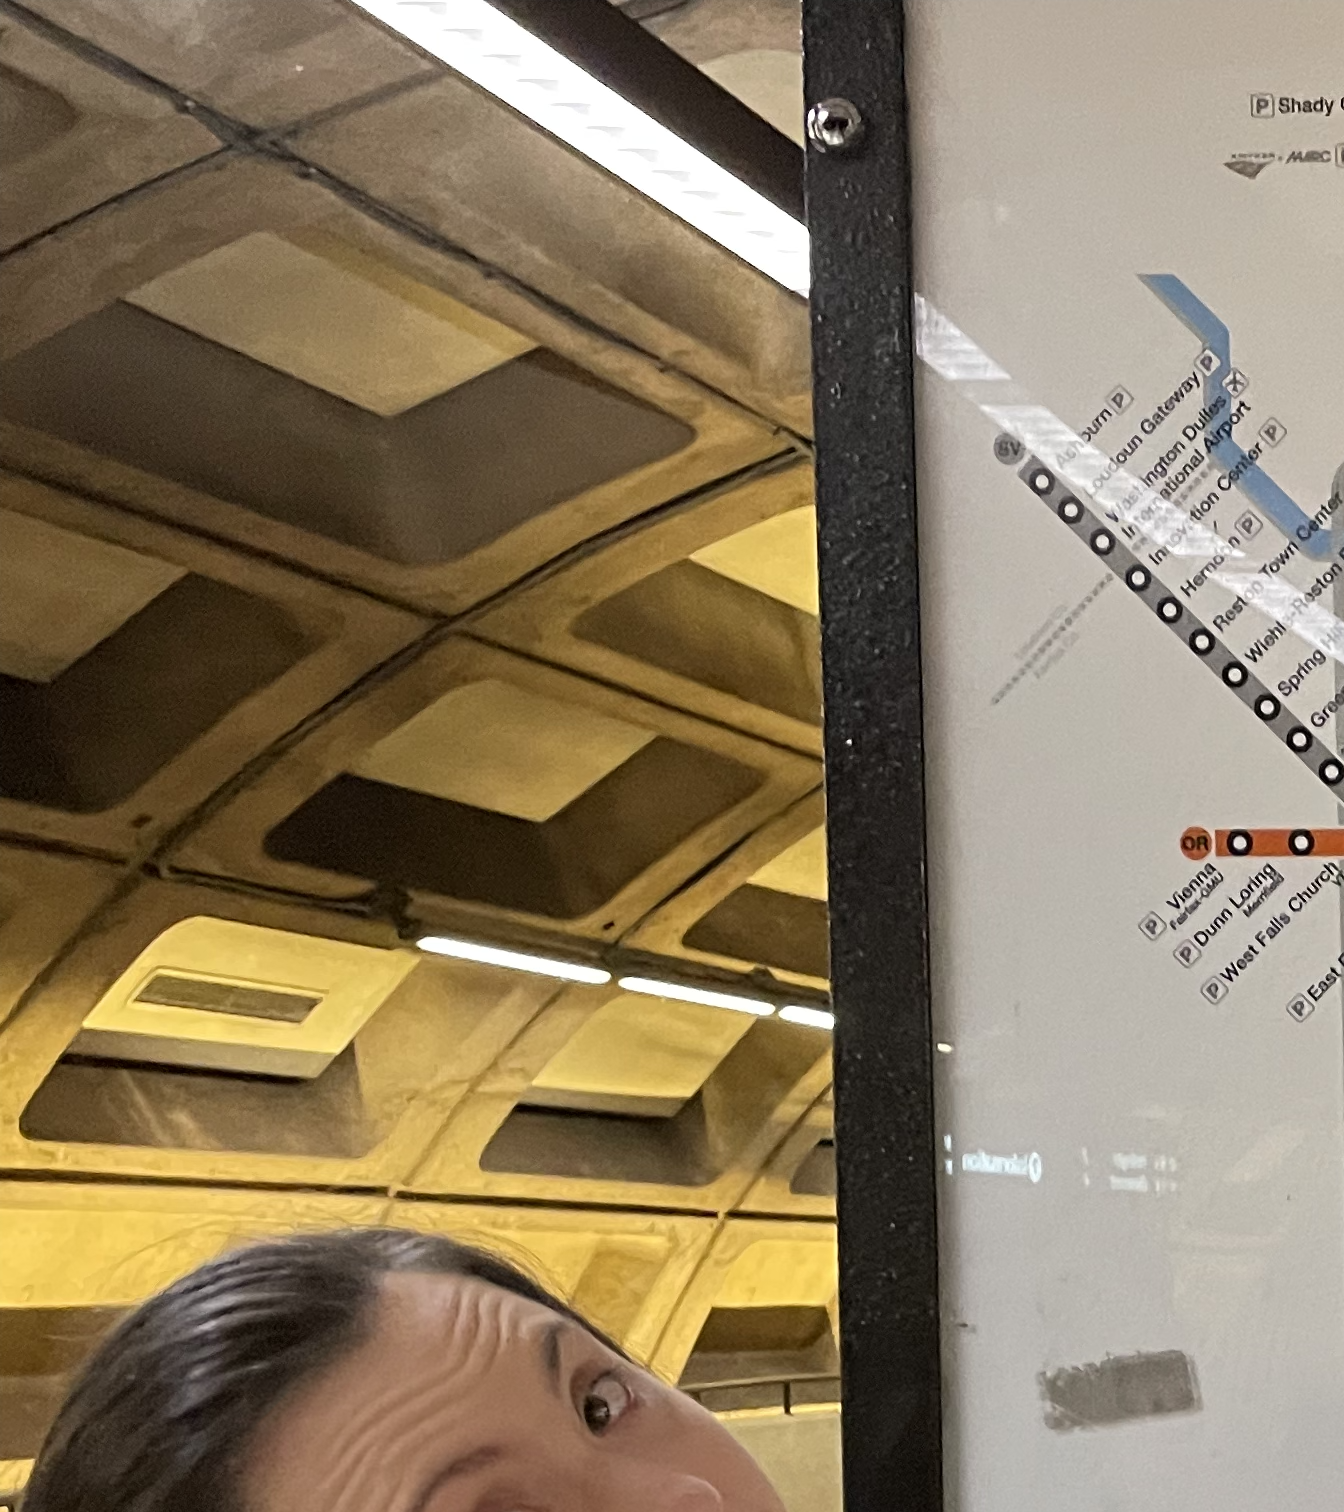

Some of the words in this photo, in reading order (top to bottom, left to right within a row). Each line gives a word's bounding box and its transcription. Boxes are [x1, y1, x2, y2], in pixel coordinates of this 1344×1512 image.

[1279, 98, 1334, 116] Shady
[1258, 540, 1298, 578] Town
[1296, 491, 1344, 541] Center
[1166, 861, 1217, 912] Vienna
[1195, 906, 1234, 947] Dunn
[1232, 862, 1277, 910] Loring
[1220, 944, 1260, 985] West
[1256, 908, 1291, 950] Falls
[1288, 861, 1339, 913] Church
